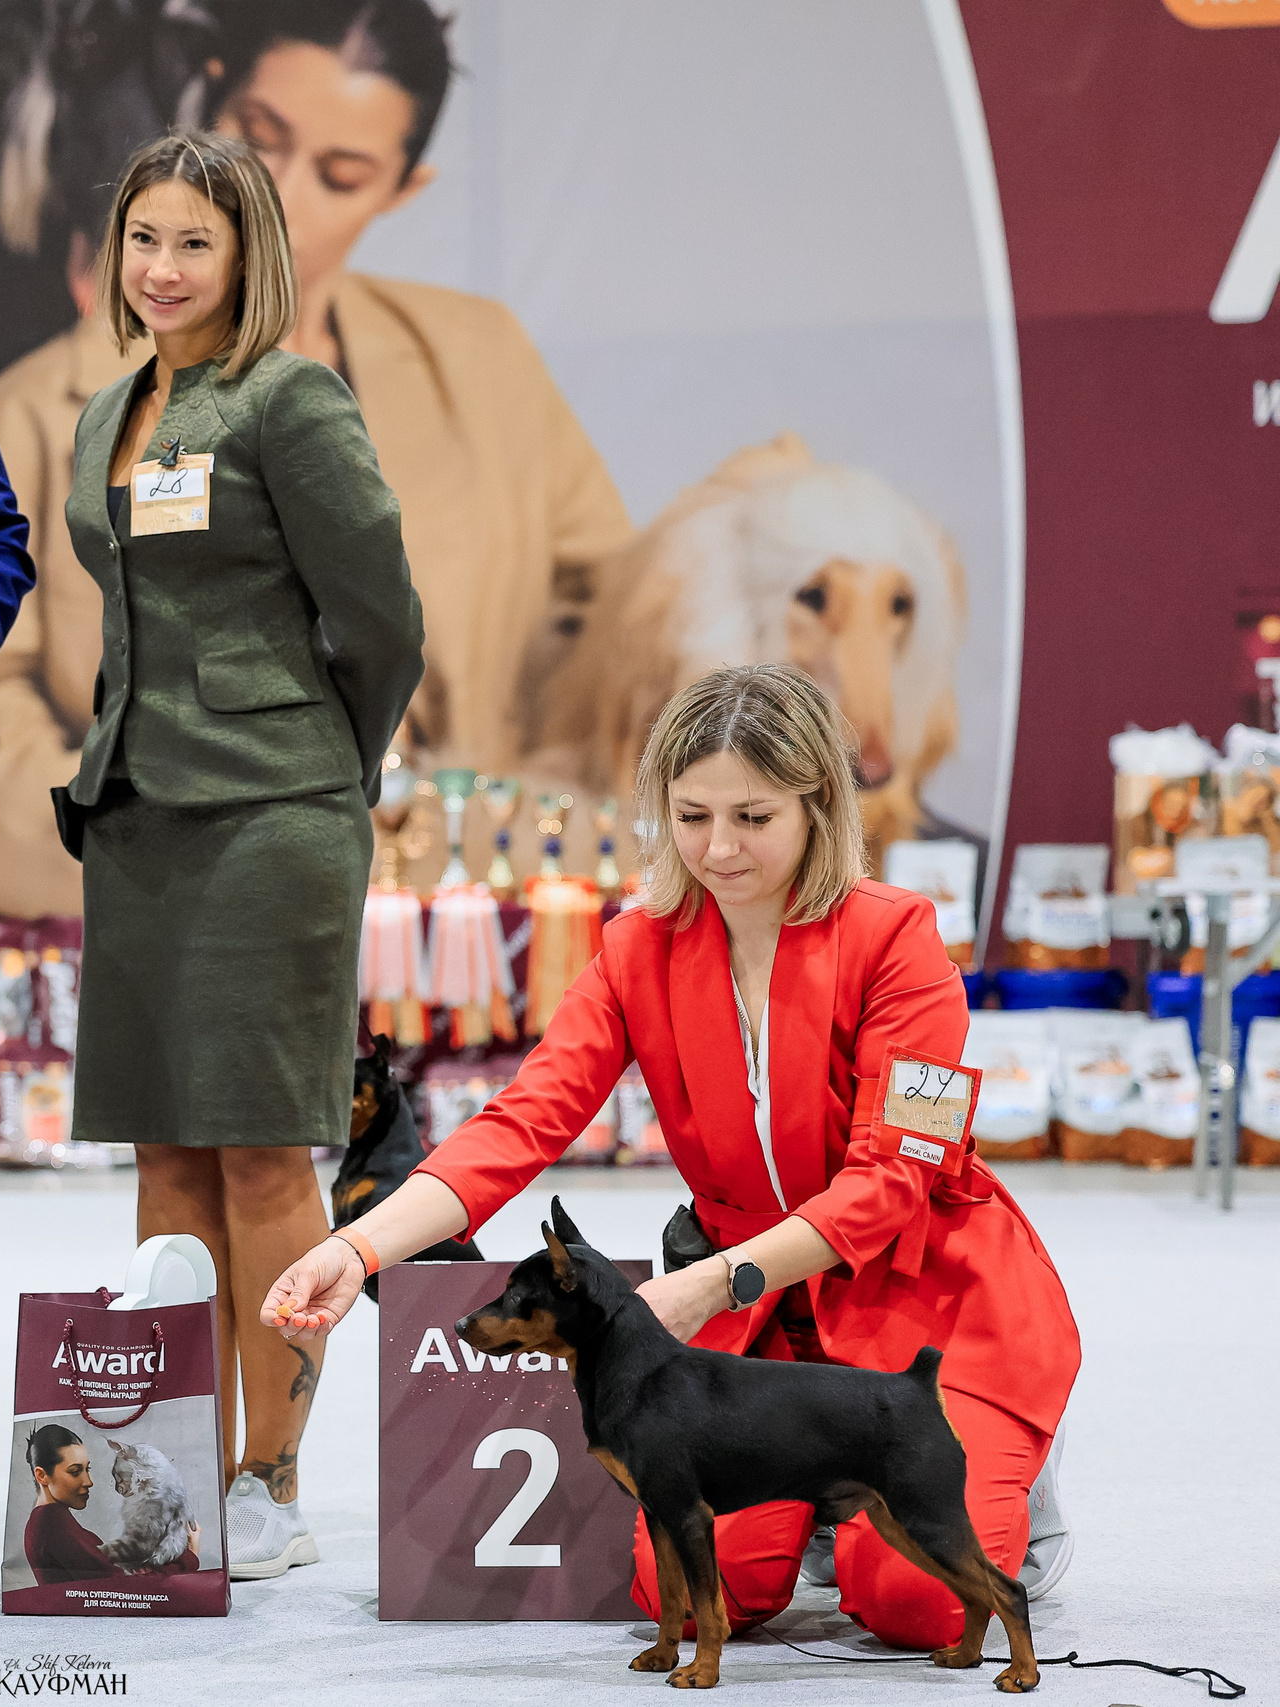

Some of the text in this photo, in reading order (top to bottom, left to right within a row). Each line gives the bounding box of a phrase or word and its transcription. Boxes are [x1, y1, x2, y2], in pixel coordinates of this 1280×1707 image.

[149, 467, 189, 497] 28
[902, 1145, 942, 1162] ROYAL CANIN
[84, 1380, 112, 1391] ПИТОМЕЦ
[110, 1391, 141, 1400] НАГРАДЫ!
[472, 1427, 562, 1568] 2
[65, 1590, 170, 1602] КОРМА СУПЕРПРЕМИУМ КЛАССА
[83, 1600, 99, 1608] ДЛЯ
[99, 1600, 121, 1608] СОБАК
